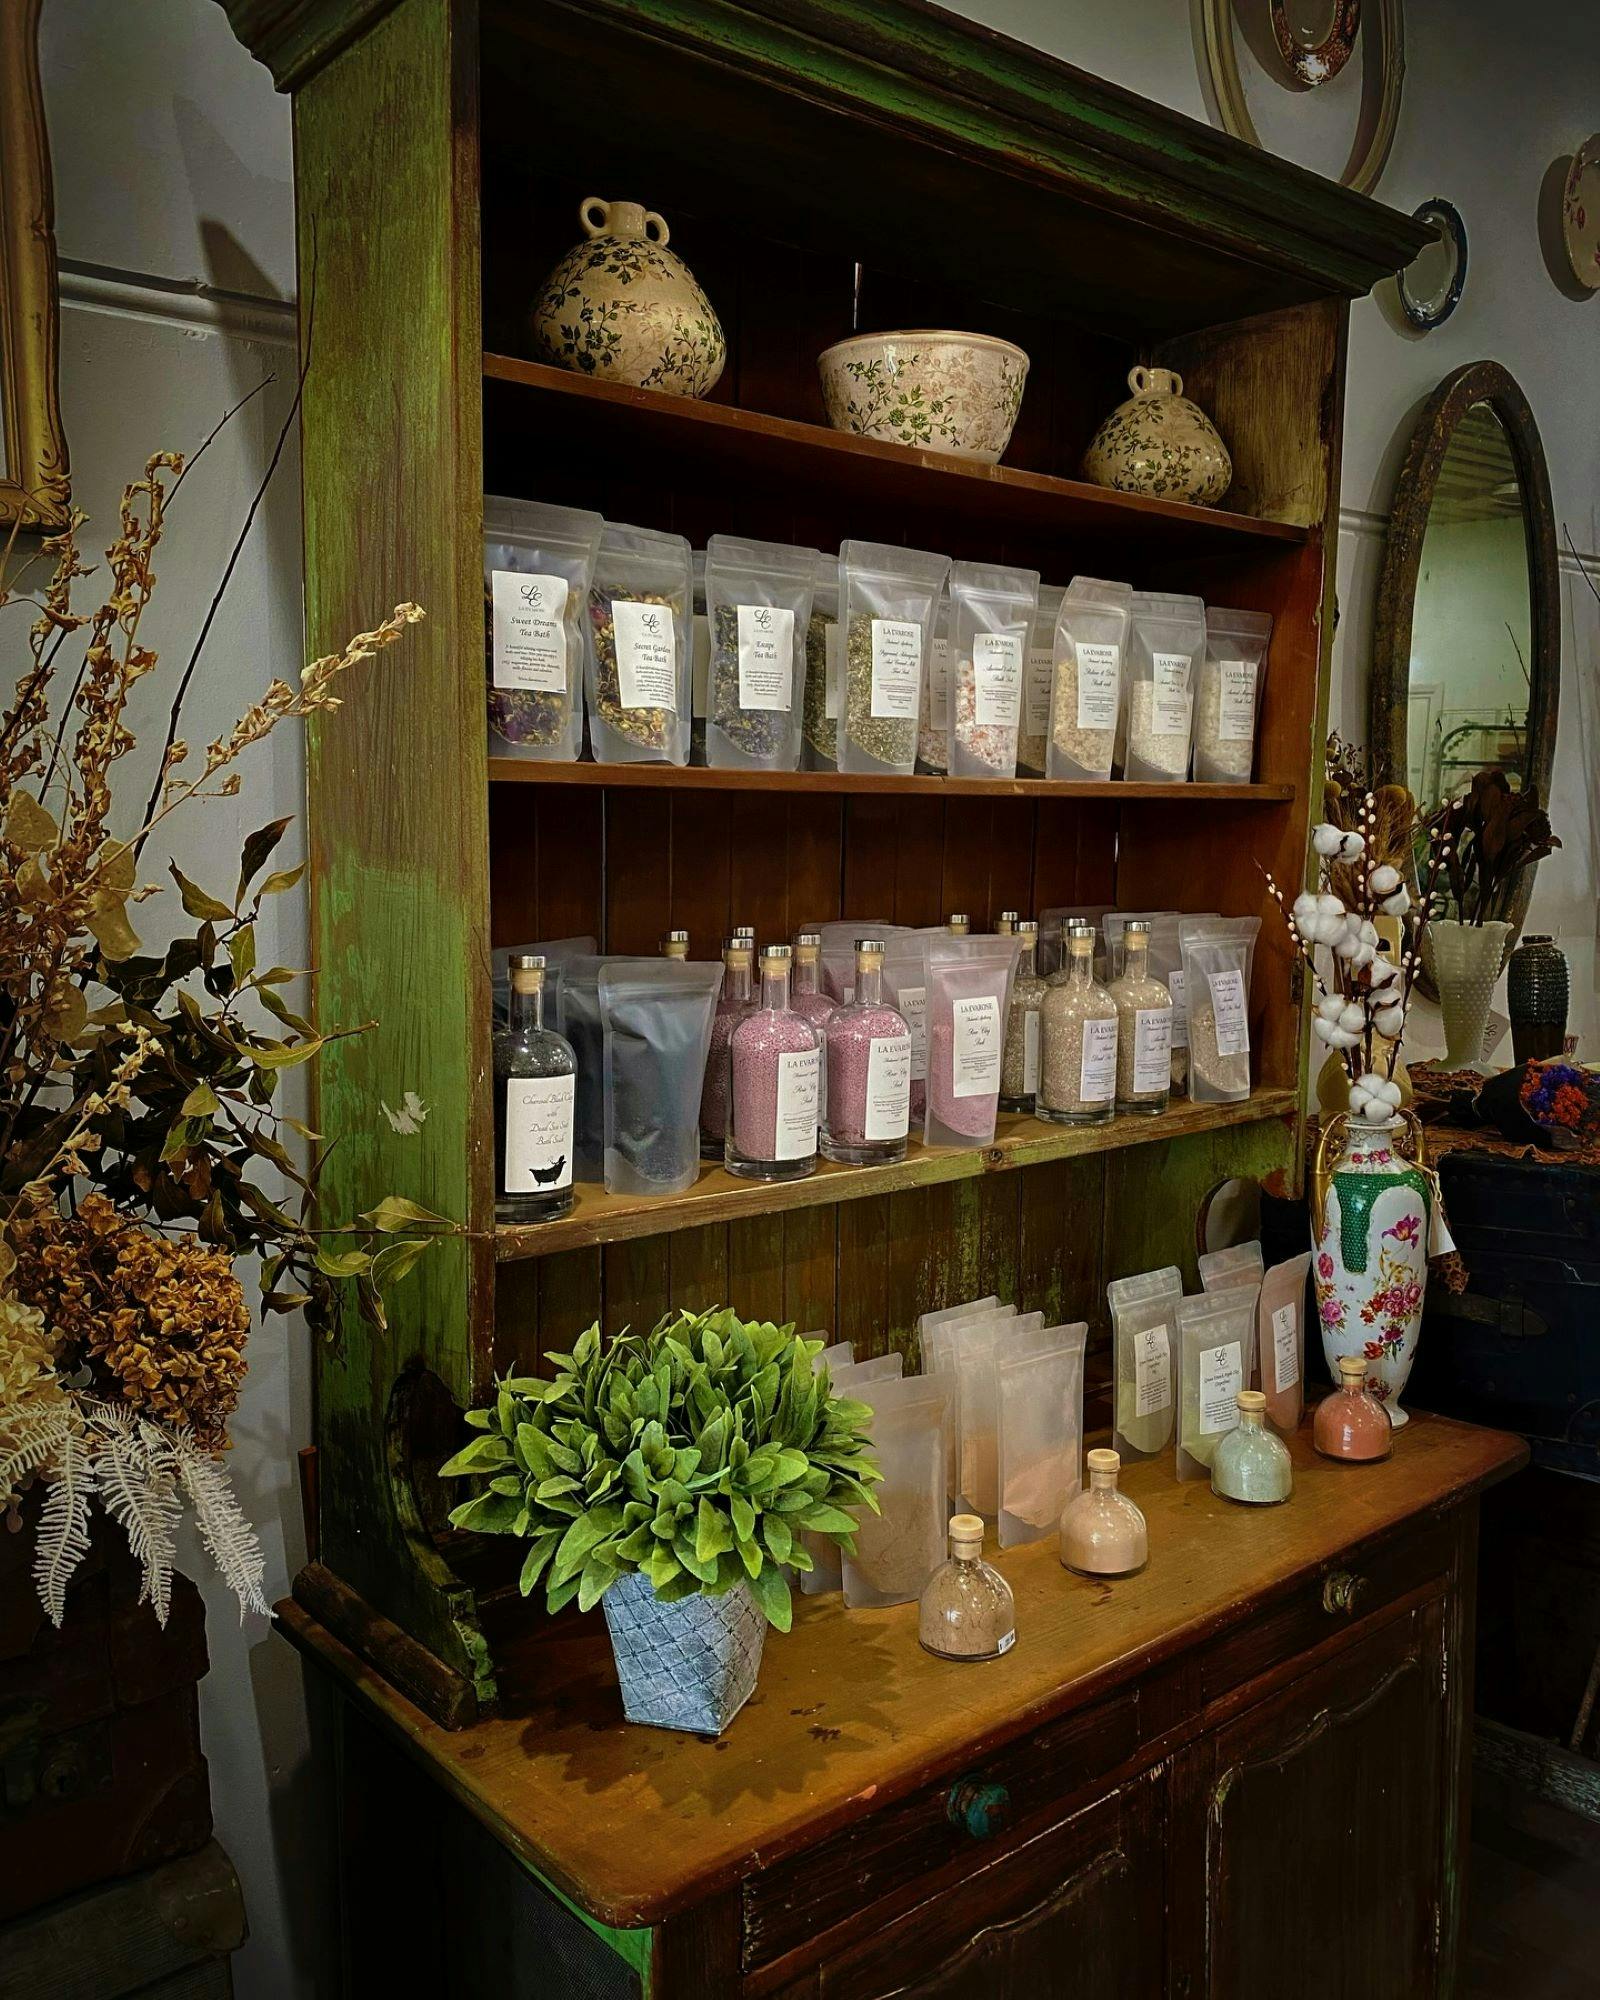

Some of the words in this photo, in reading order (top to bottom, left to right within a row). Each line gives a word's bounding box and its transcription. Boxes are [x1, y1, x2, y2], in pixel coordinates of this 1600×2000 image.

[511, 617, 531, 625] Sweet
[533, 619, 557, 628] Dreams
[533, 630, 550, 638] Bath
[634, 643, 651, 651] Secret
[653, 644, 670, 653] Garden
[756, 641, 774, 650] Escape
[642, 653, 652, 661] Tea
[654, 655, 667, 663] Bath
[765, 652, 777, 660] Bath
[960, 1005, 968, 1013] LA
[968, 1003, 993, 1012] EVAROSE
[1090, 1026, 1100, 1034] LA
[522, 1094, 549, 1105] Charcoal
[529, 1121, 549, 1132] Dead
